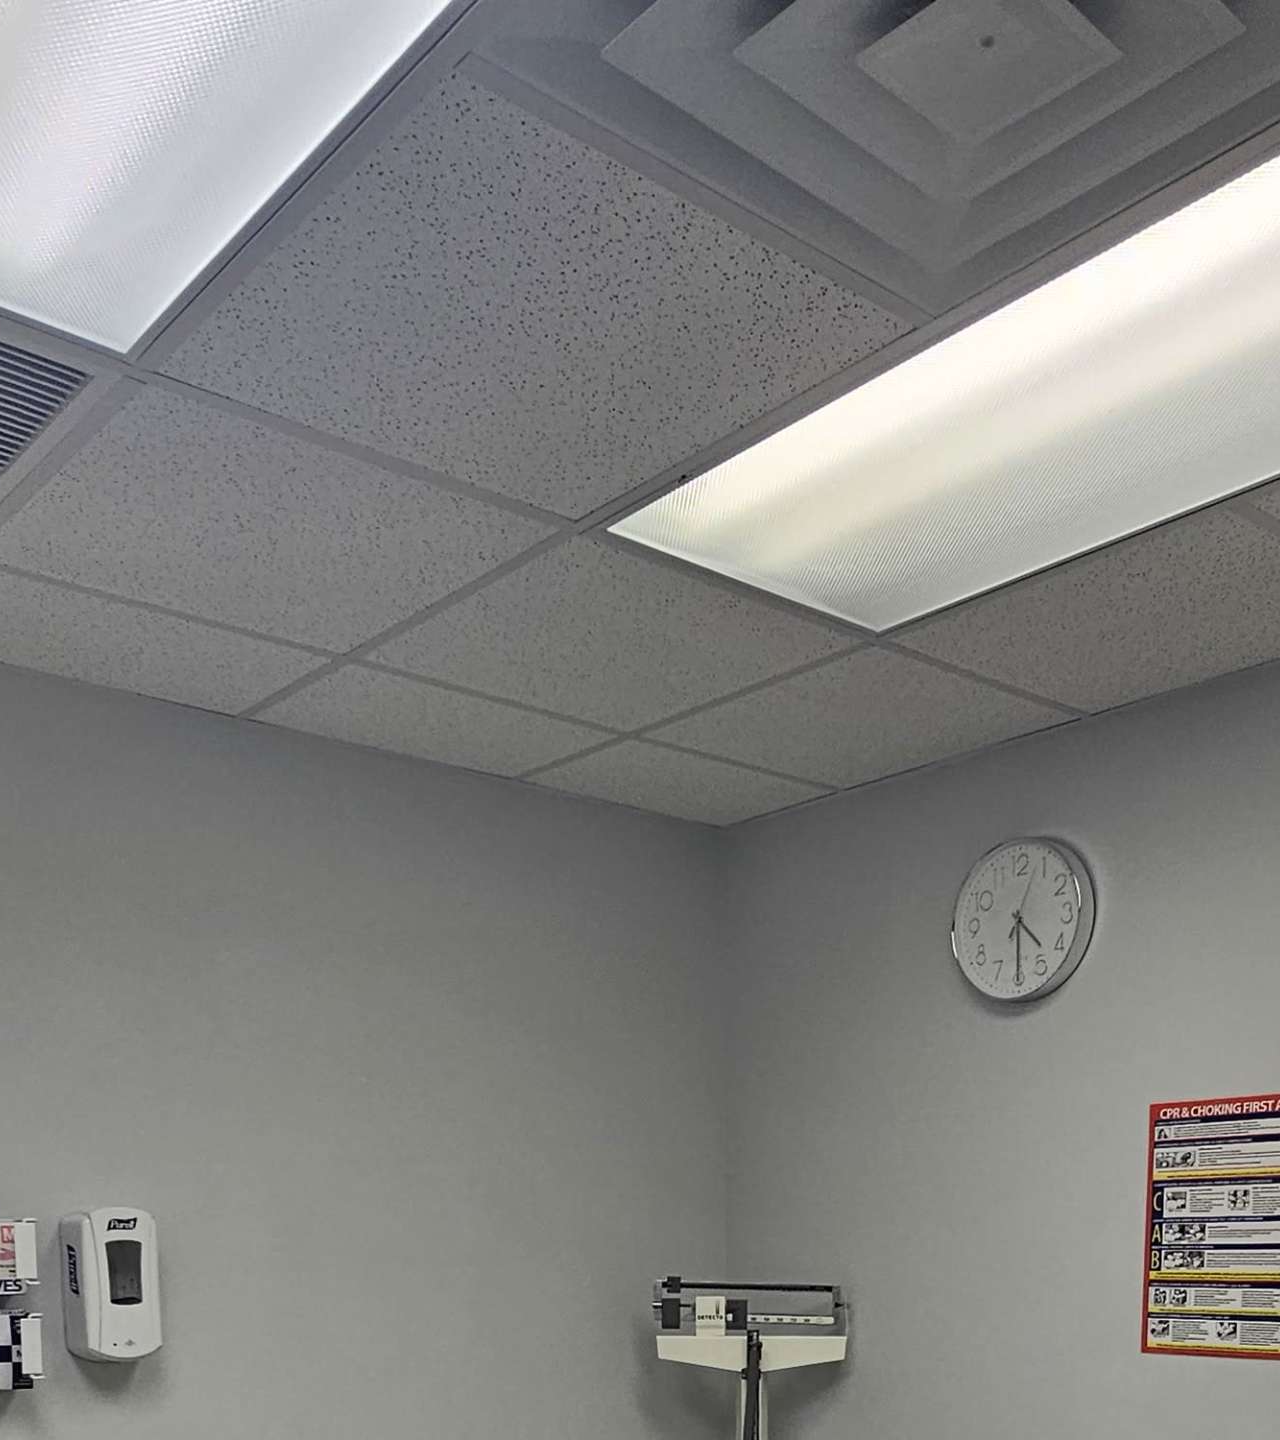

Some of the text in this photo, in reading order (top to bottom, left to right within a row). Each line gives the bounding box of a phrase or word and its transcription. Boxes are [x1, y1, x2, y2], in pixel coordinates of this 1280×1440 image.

[1012, 853, 1029, 876] 12
[993, 866, 1005, 890] 11
[1054, 874, 1067, 896] 2
[971, 890, 994, 912] 10
[1061, 902, 1073, 924] 3
[969, 918, 980, 939] 9
[1054, 932, 1065, 951] 4
[976, 944, 986, 966] 8
[1034, 954, 1048, 976] 5
[993, 960, 1003, 981] 7
[1160, 1105, 1181, 1119] CPR
[1181, 1105, 1189, 1118] &
[1191, 1102, 1242, 1117] CHOKING
[1243, 1100, 1275, 1113] FIRST
[1153, 1193, 1162, 1212] C
[1152, 1224, 1161, 1243] A
[1151, 1250, 1160, 1270] B
